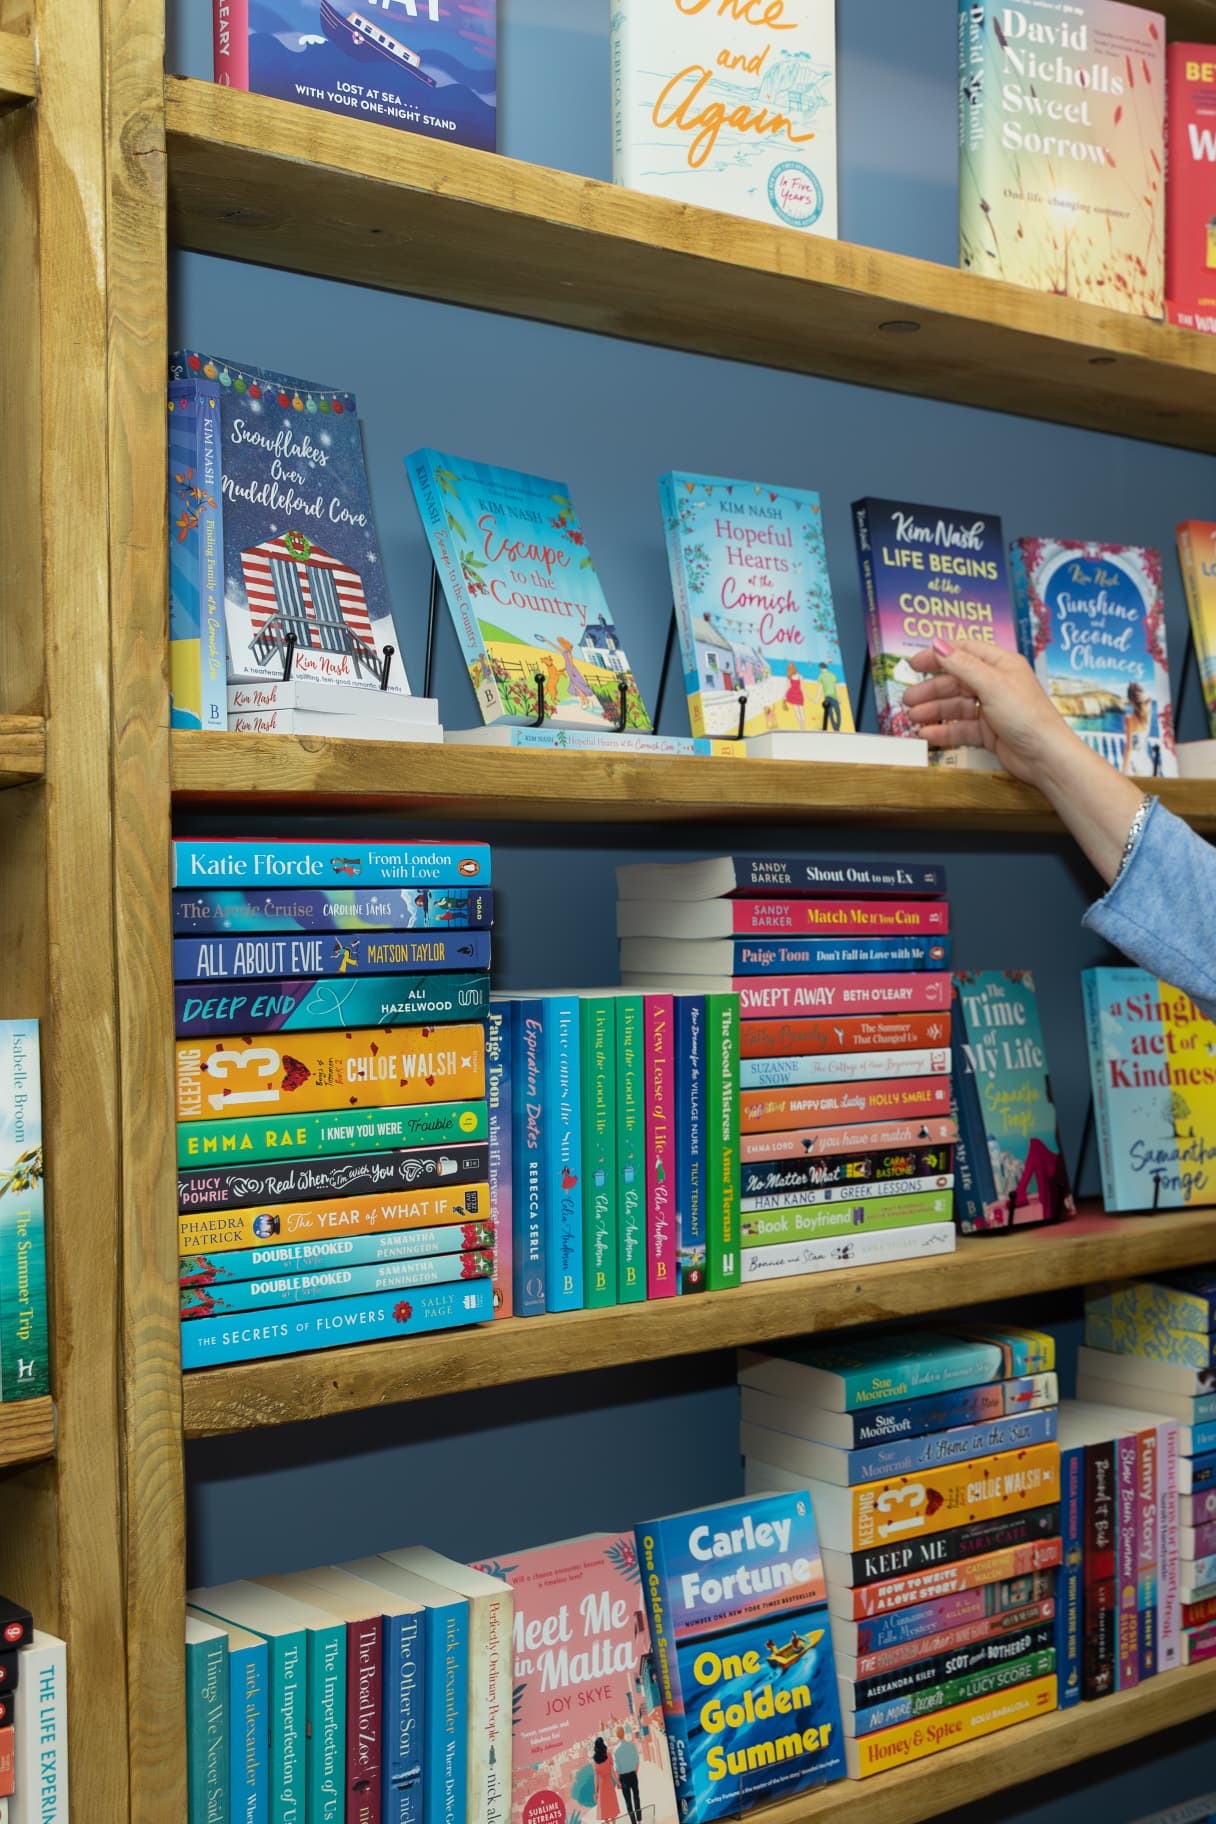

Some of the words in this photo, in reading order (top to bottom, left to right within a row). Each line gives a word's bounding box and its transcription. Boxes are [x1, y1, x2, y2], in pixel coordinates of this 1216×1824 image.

[1001, 9, 1089, 52] David
[716, 45, 771, 77] and
[1001, 48, 1125, 97] Nicholls
[295, 83, 325, 99] WITH
[327, 89, 358, 107] YOUR
[360, 96, 421, 120] ONE-NIGHT
[422, 111, 457, 131] STAND
[337, 80, 364, 94] LOST
[366, 85, 381, 98] AT
[380, 89, 402, 105] SEA
[1001, 84, 1092, 127] Sweet
[650, 66, 816, 169] Again
[1001, 120, 1110, 167] Sorrow
[230, 418, 330, 467] Snowflakes
[270, 459, 306, 487] Over
[328, 499, 368, 528] Cove
[719, 501, 746, 517] KIM
[749, 504, 783, 521] NASH
[477, 514, 571, 570] Escape
[713, 518, 795, 549] Hopeful
[891, 511, 933, 543] Kim
[935, 520, 986, 551] Nash
[726, 544, 790, 574] Hearts
[882, 546, 924, 570] LIFE
[929, 553, 999, 581] BEGINS
[528, 570, 557, 591] the
[720, 577, 800, 613] Cornish
[489, 578, 588, 627] Country
[899, 593, 993, 623] CORNISH
[1056, 590, 1140, 621] Sunshine
[758, 612, 805, 646] Cove
[902, 617, 996, 645] COTTAGE
[1060, 621, 1134, 652] Second
[295, 651, 322, 672] Kim
[323, 654, 350, 676] Nash
[1069, 646, 1147, 680] Chances
[190, 853, 247, 876] Katie
[253, 854, 324, 876] Fforde
[368, 851, 402, 866] From
[405, 852, 451, 866] London
[380, 865, 407, 878] with
[410, 866, 441, 878] Love
[806, 866, 844, 882] Shout
[847, 868, 870, 883] Out
[897, 870, 914, 885] Ex
[197, 943, 228, 976] ALL
[233, 942, 287, 974] ABOUT
[291, 941, 324, 972] EVIE
[367, 944, 409, 963] MATSON
[410, 942, 446, 962] TAYLOR
[182, 995, 247, 1023] DEEP
[251, 995, 296, 1017] END
[381, 1001, 452, 1013] HAZELWOOD
[407, 989, 426, 1000] ALI
[741, 988, 791, 1007] SWEPT
[794, 987, 835, 1006] AWAY
[843, 990, 870, 1001] BETH
[872, 988, 913, 1000] O'LEARY
[12, 1032, 25, 1089] Isabelle
[346, 1056, 397, 1083] CHLOE
[401, 1052, 457, 1078] WALSH
[524, 1018, 543, 1097] Expiration
[15, 1094, 25, 1144] Broom
[320, 1128, 324, 1141] I
[327, 1127, 355, 1140] KNEW
[356, 1124, 375, 1138] YOU
[377, 1121, 402, 1136] WERE
[407, 1116, 454, 1133] Trouble
[526, 1103, 542, 1150] Dates
[188, 1133, 253, 1155] EMMA
[265, 1128, 307, 1147] RAE
[189, 1177, 221, 1191] LUCY
[266, 1170, 295, 1195] Real
[297, 1166, 330, 1190] When
[348, 1166, 369, 1179] with
[371, 1164, 394, 1183] You
[529, 1162, 538, 1218] REBECCA
[840, 1185, 873, 1199] GREEK
[877, 1180, 922, 1195] LESSONS
[182, 1190, 229, 1204] POWRIE
[755, 1194, 779, 1209] HAN
[784, 1191, 816, 1206] KANG
[18, 1208, 31, 1236] The
[288, 1214, 314, 1232] The
[317, 1209, 360, 1228] YEAR
[365, 1206, 378, 1226] of
[380, 1203, 429, 1220] WHAT
[434, 1200, 448, 1215] IF
[529, 1223, 539, 1262] SERLE
[18, 1241, 32, 1305] Summer
[16, 1306, 33, 1341] Trip
[198, 1336, 217, 1346] THE
[222, 1325, 288, 1345] SECRETS
[296, 1321, 309, 1332] OF
[316, 1309, 385, 1330] FLOWERS
[688, 1516, 791, 1560] Carley
[865, 1550, 912, 1577] KEEP
[920, 1542, 948, 1561] ME
[681, 1558, 810, 1609] Fortune
[579, 1590, 629, 1634] Me
[400, 1619, 418, 1656] The
[514, 1659, 535, 1678] in
[536, 1638, 637, 1693] Malta
[693, 1651, 761, 1685] One
[40, 1665, 55, 1702] THE
[400, 1662, 417, 1715] Other
[545, 1697, 573, 1716] JOY
[579, 1685, 612, 1706] SKYE
[40, 1707, 56, 1744] LIFE
[699, 1684, 812, 1734] Golden
[400, 1719, 417, 1757] Son
[706, 1722, 833, 1781] Summer
[867, 1737, 911, 1763] Honey
[913, 1730, 924, 1747] &
[926, 1719, 963, 1744] Spice
